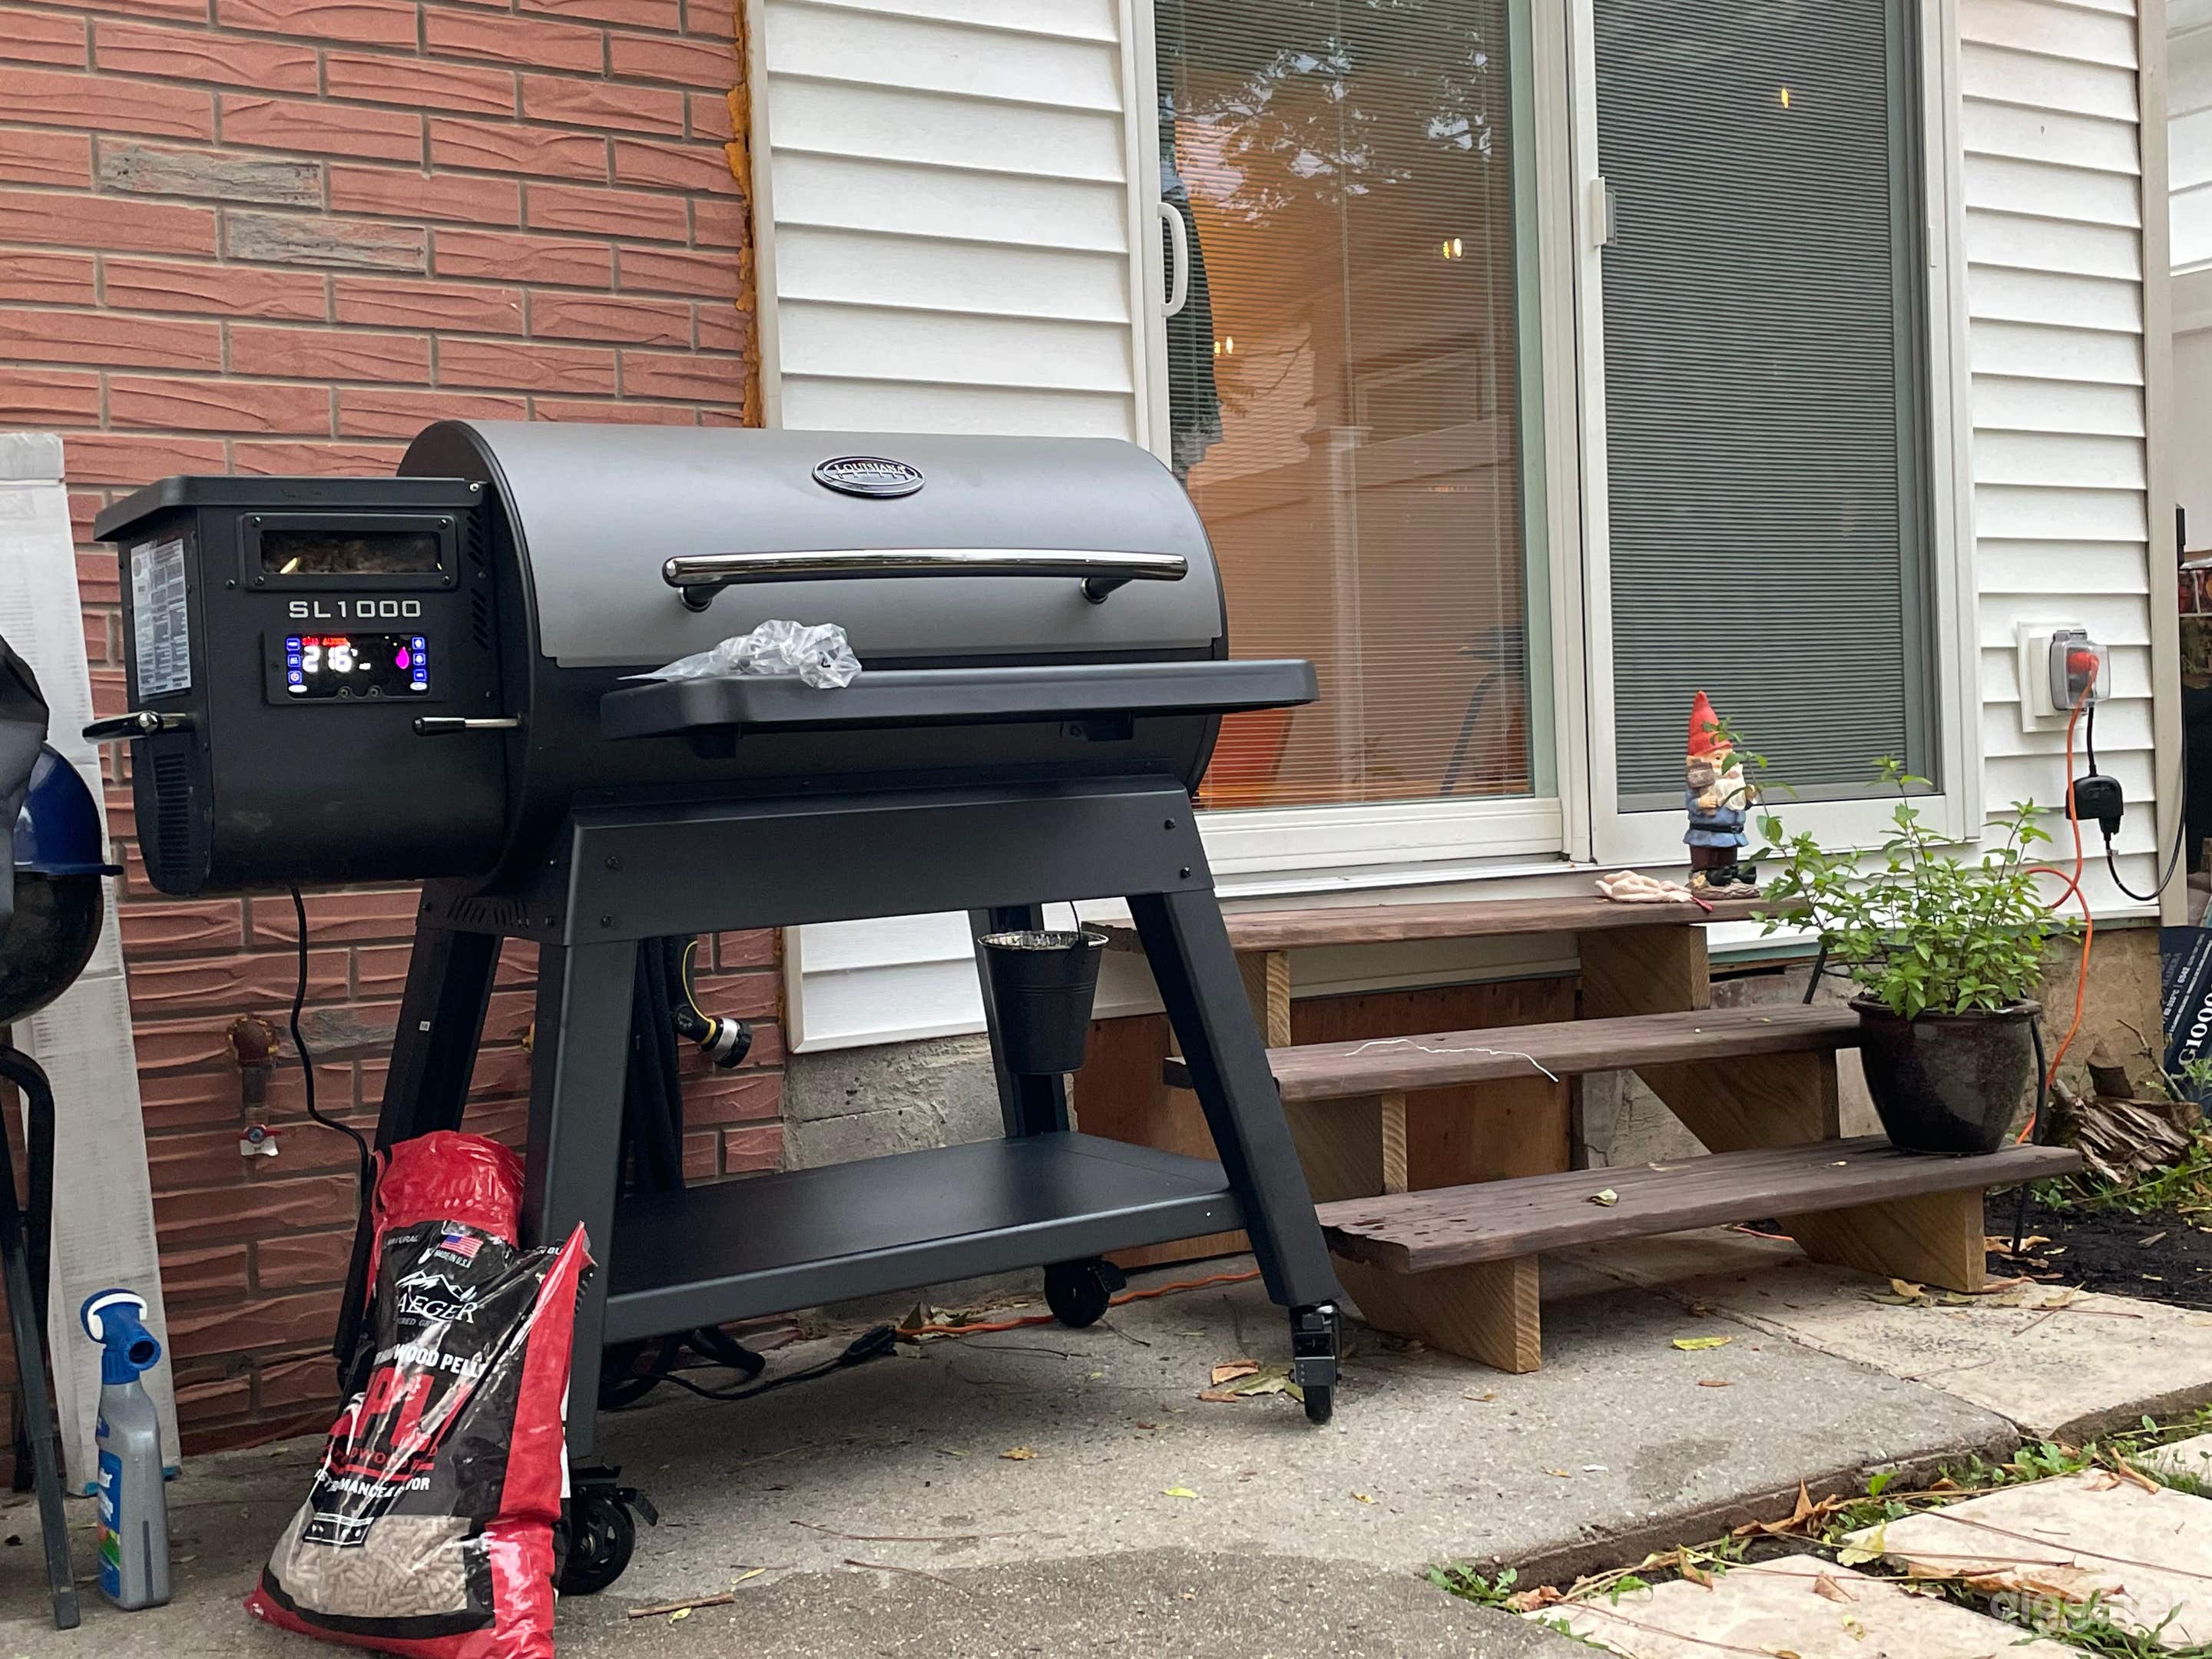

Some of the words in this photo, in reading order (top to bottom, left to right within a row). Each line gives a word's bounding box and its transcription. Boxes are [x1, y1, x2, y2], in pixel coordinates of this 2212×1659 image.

[833, 462, 908, 475] LOUISIANA
[289, 601, 421, 618] SL1000
[397, 1293, 478, 1323] AEGER
